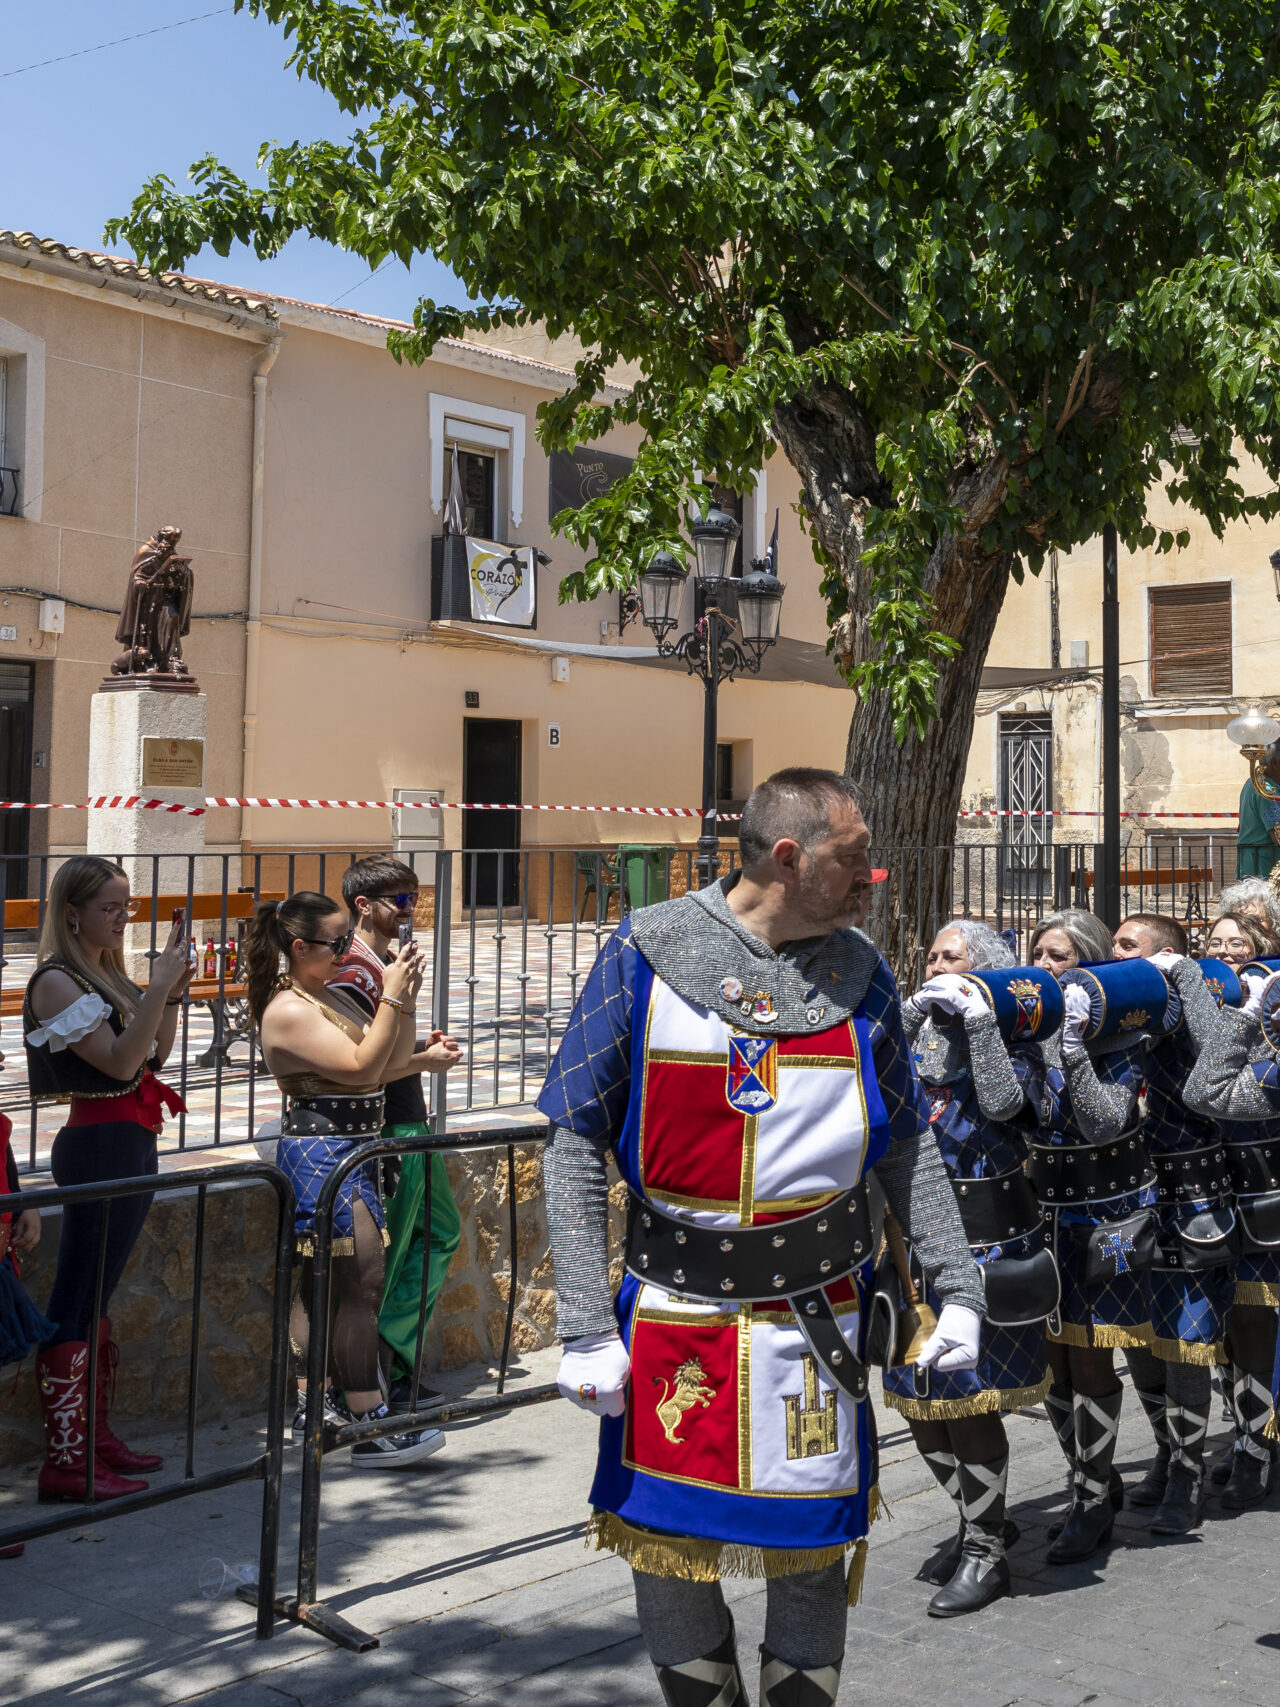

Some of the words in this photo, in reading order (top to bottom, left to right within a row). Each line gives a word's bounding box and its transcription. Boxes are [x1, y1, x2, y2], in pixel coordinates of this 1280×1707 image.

[576, 462, 604, 476] PUNTO
[471, 569, 522, 586] CORAZÓN
[549, 728, 560, 745] B
